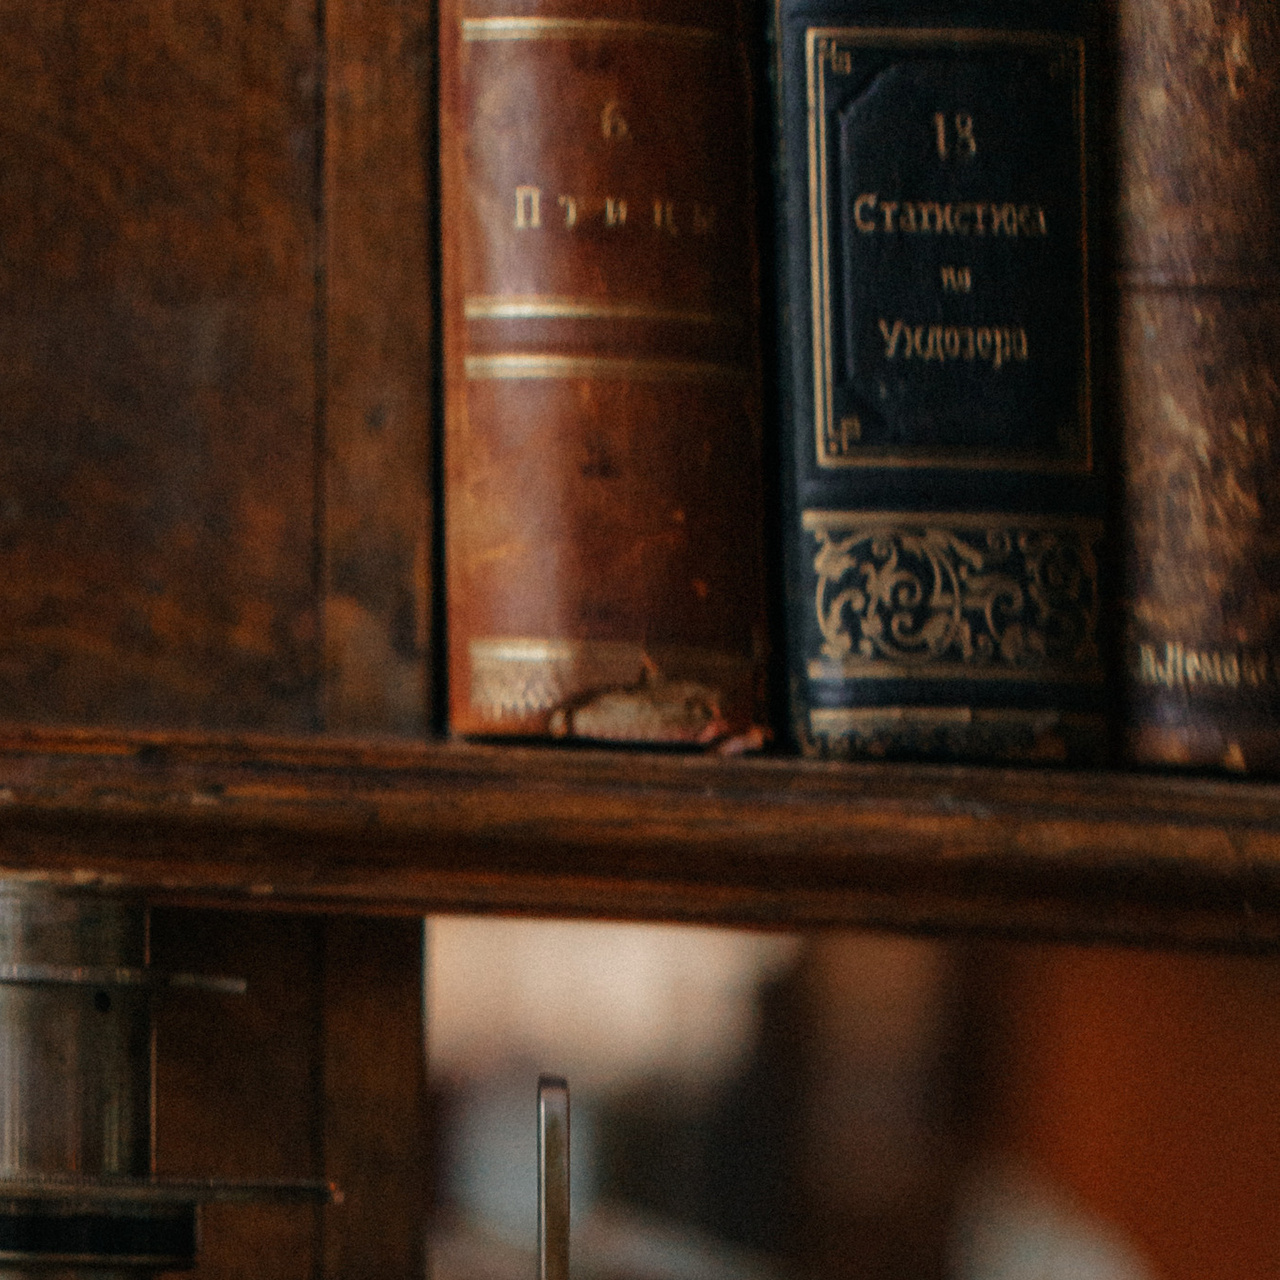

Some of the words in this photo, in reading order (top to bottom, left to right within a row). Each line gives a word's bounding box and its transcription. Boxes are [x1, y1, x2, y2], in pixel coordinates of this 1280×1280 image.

[600, 99, 630, 142] 6
[931, 111, 979, 161] 18
[852, 191, 1050, 237] Статистика
